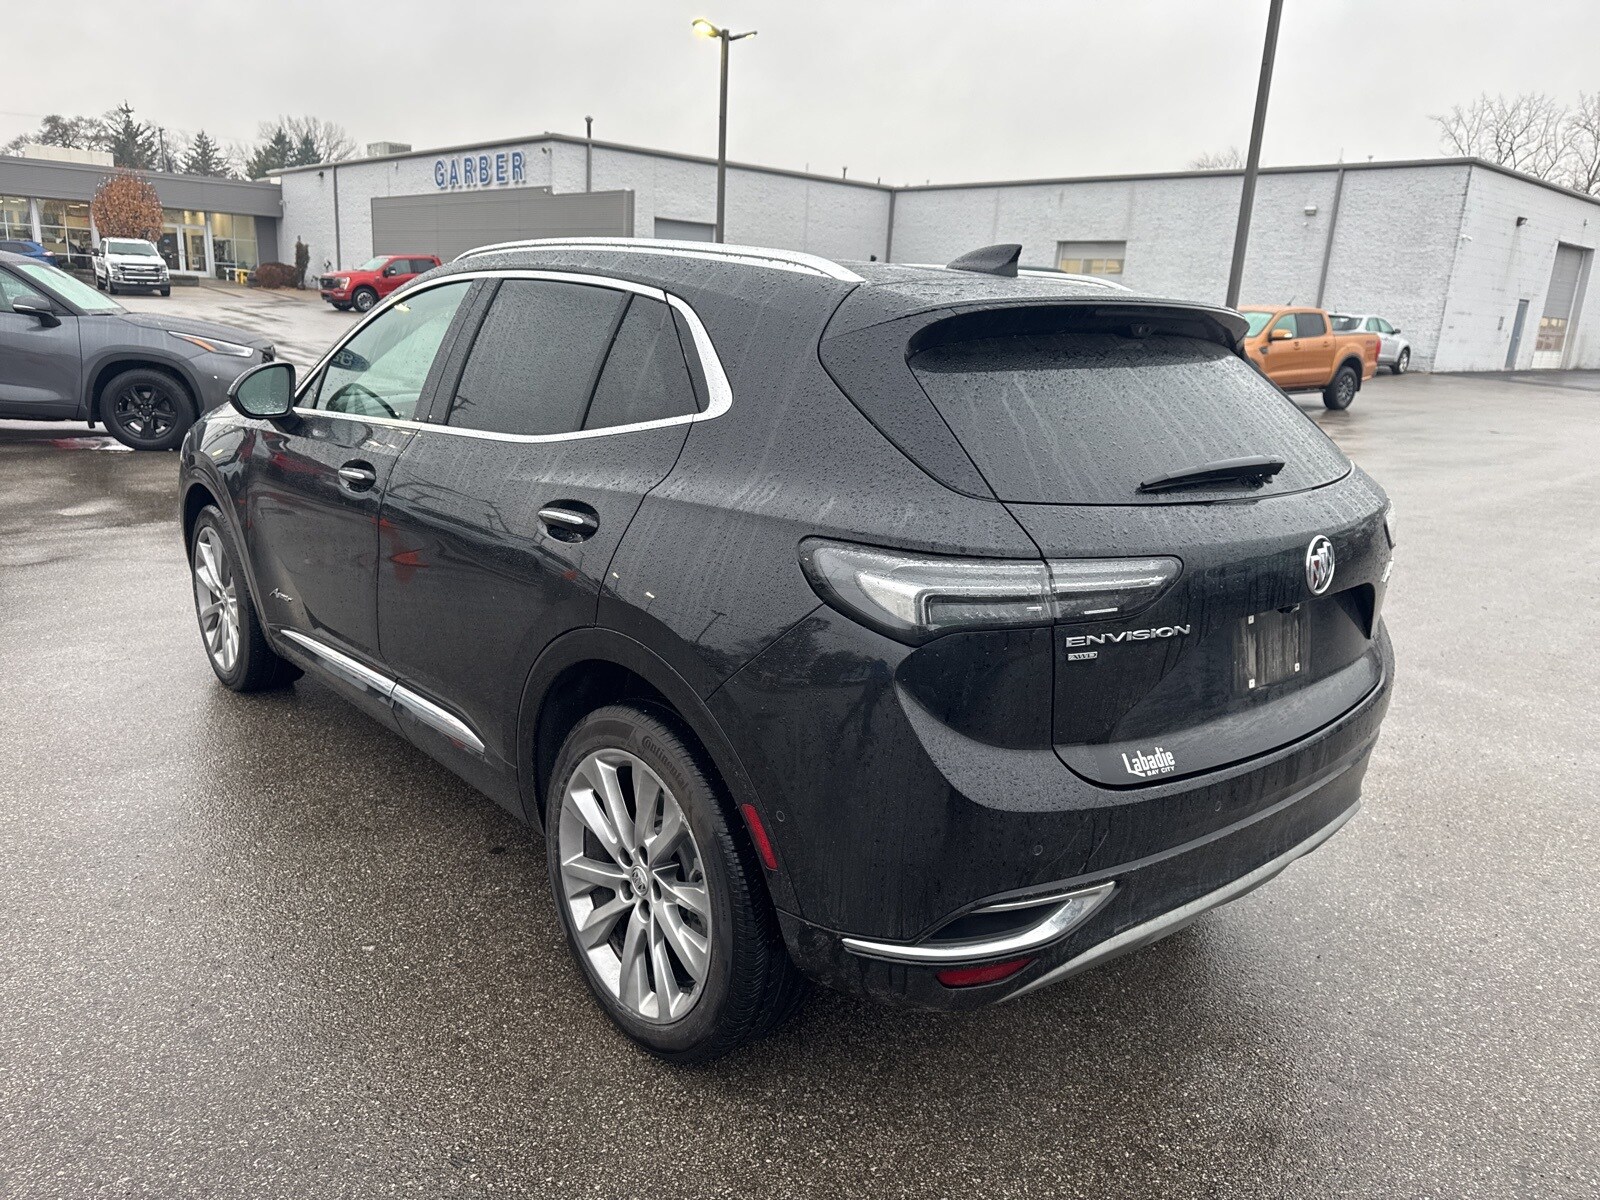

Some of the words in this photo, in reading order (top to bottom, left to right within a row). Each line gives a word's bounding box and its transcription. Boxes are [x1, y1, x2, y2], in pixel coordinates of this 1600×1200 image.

[434, 151, 525, 187] GARBER
[1066, 624, 1191, 647] ENVISION
[1068, 651, 1098, 660] AWD
[1121, 746, 1176, 777] Labadie
[1146, 769, 1159, 777] BAY
[1160, 765, 1175, 773] CITY
